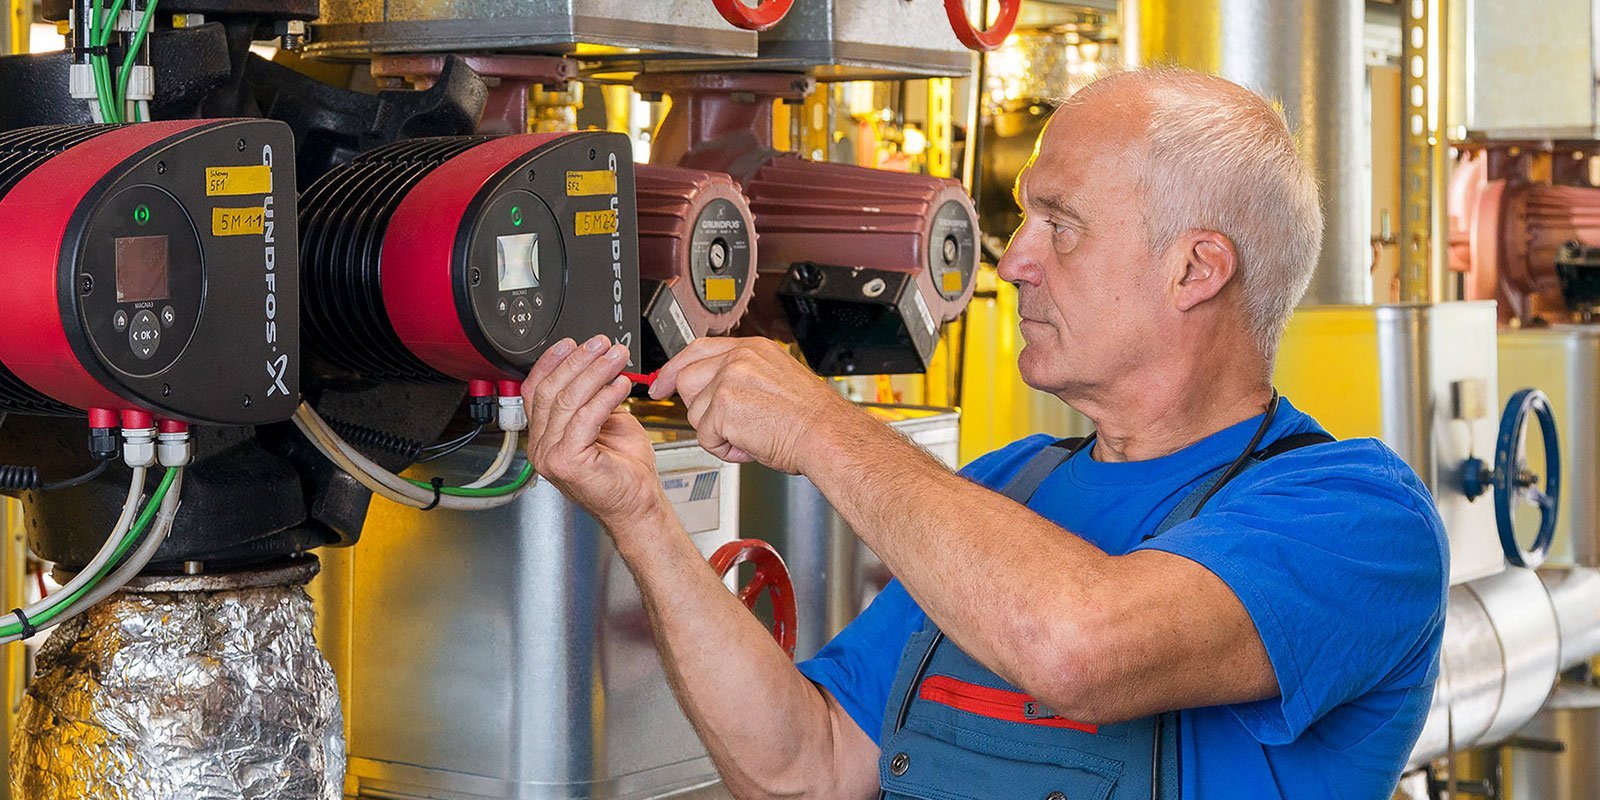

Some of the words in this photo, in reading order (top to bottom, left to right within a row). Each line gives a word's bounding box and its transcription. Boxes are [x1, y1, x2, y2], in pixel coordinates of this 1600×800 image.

[702, 220, 740, 229] GRUNDFOS
[262, 144, 276, 344] GUNDFOS
[517, 313, 526, 322] OK
[140, 330, 151, 340] OK
